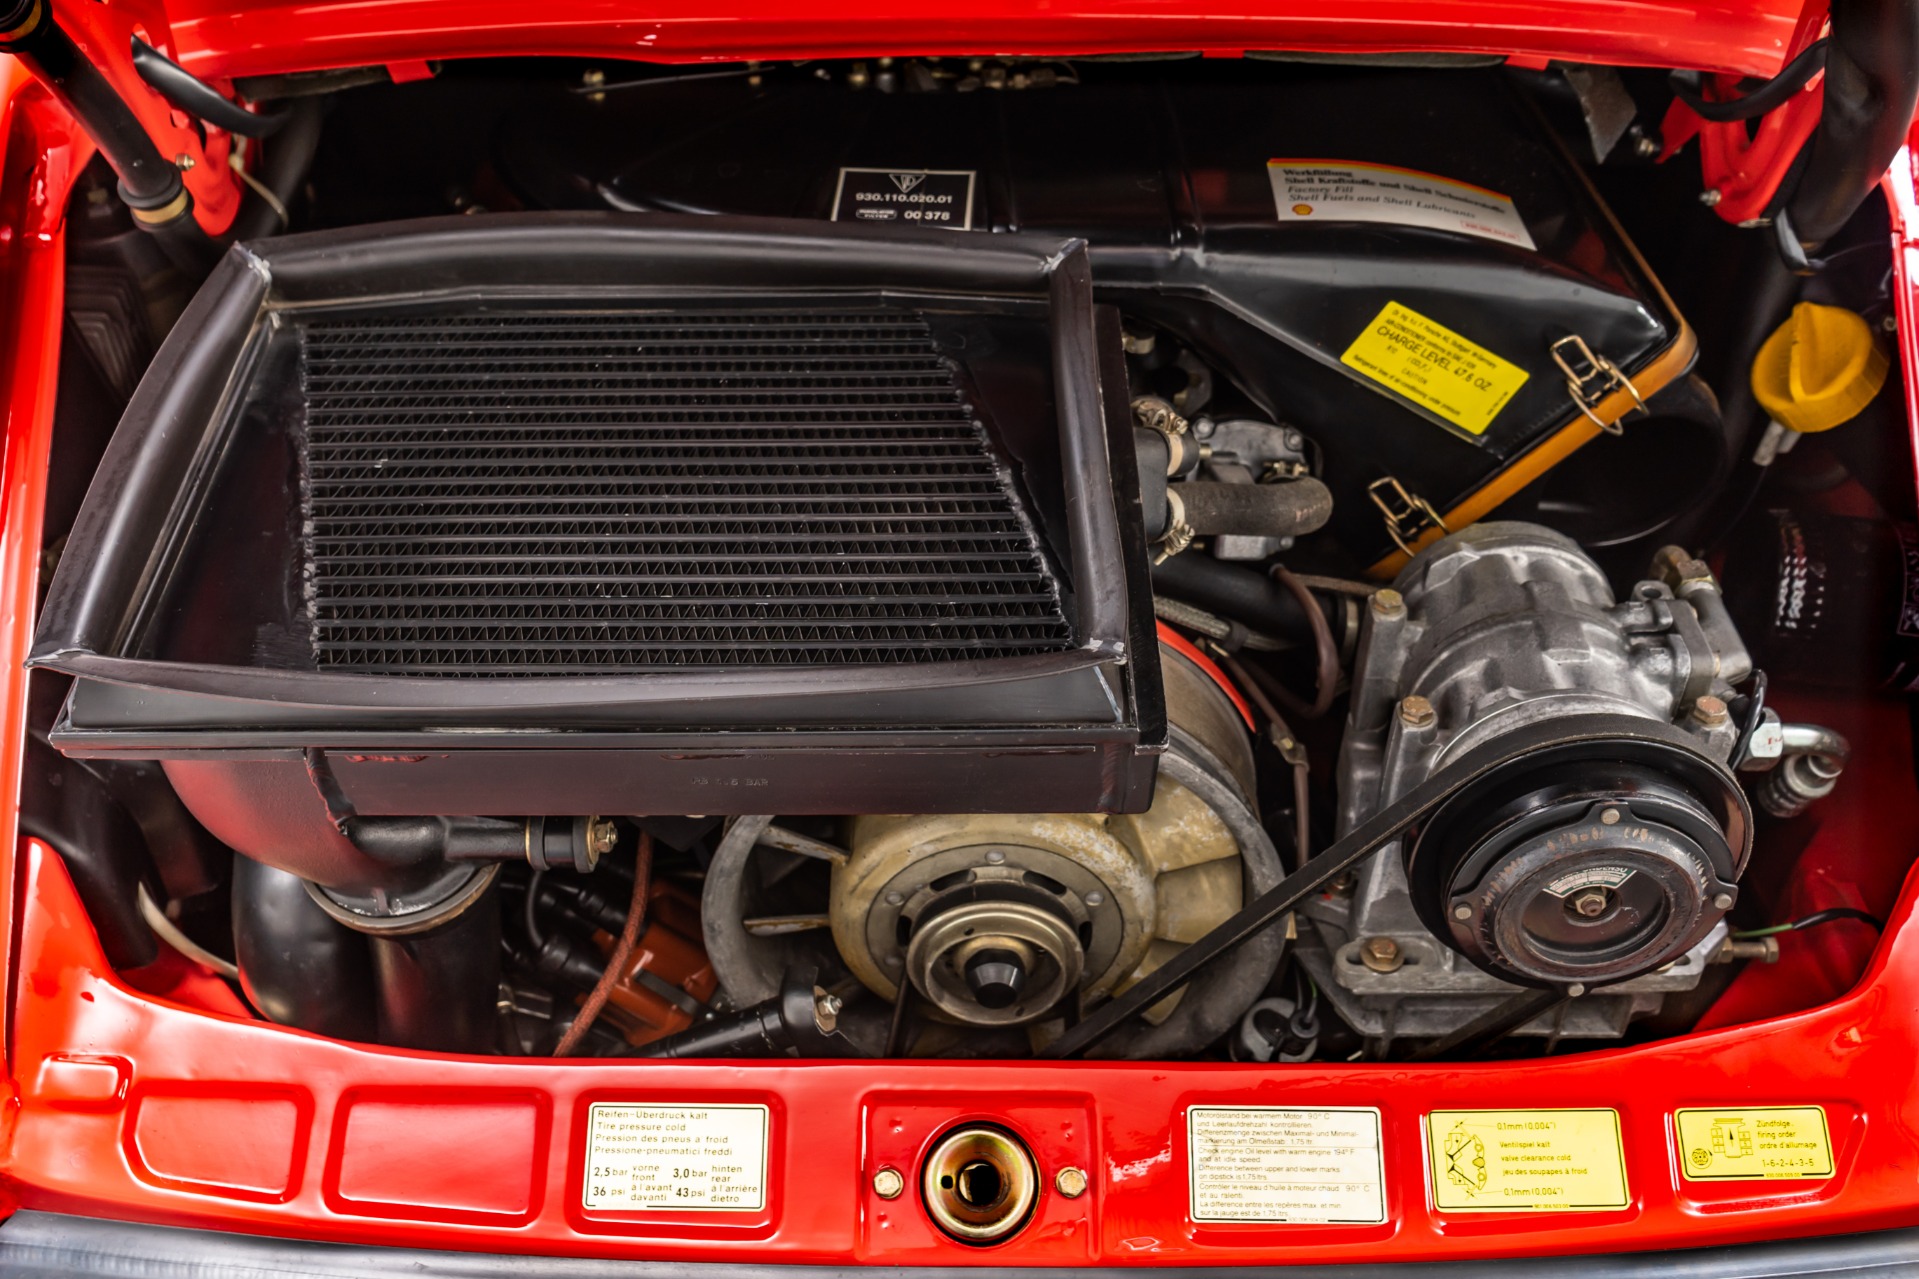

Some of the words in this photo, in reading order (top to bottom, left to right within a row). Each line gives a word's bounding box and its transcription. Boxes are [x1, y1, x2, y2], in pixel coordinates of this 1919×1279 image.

[1288, 186, 1330, 194] Factory
[1318, 177, 1376, 186] Kraftstoffe
[1403, 184, 1432, 194] Shell
[855, 193, 953, 204] 930.110.020.01
[1383, 196, 1412, 206] Shell
[1417, 201, 1476, 218] Lubricants
[904, 210, 922, 220] 00
[924, 211, 950, 221] 378
[1376, 325, 1422, 353] CHARGE
[1419, 347, 1451, 371] LEVEL
[1473, 377, 1492, 391] OZ
[690, 1112, 708, 1120] kalt
[598, 1122, 616, 1130] Tire
[1197, 1129, 1250, 1137] Differenzmenge
[1757, 1131, 1776, 1139] firing
[596, 1134, 638, 1142] Pression
[706, 1136, 729, 1144] froid
[1500, 1141, 1534, 1149] Ventilspiel
[595, 1146, 700, 1155] Pressione-pneumatici
[704, 1148, 732, 1156] freddi
[1762, 1158, 1814, 1167] 1-6-2-4-3-5
[594, 1167, 610, 1178] 2,5
[673, 1168, 690, 1179] 3,0
[711, 1165, 743, 1173] hinten
[1503, 1168, 1513, 1176] jeu
[593, 1186, 606, 1196] 36
[611, 1188, 625, 1196] psi
[676, 1188, 689, 1197] 43
[691, 1189, 705, 1198] psi
